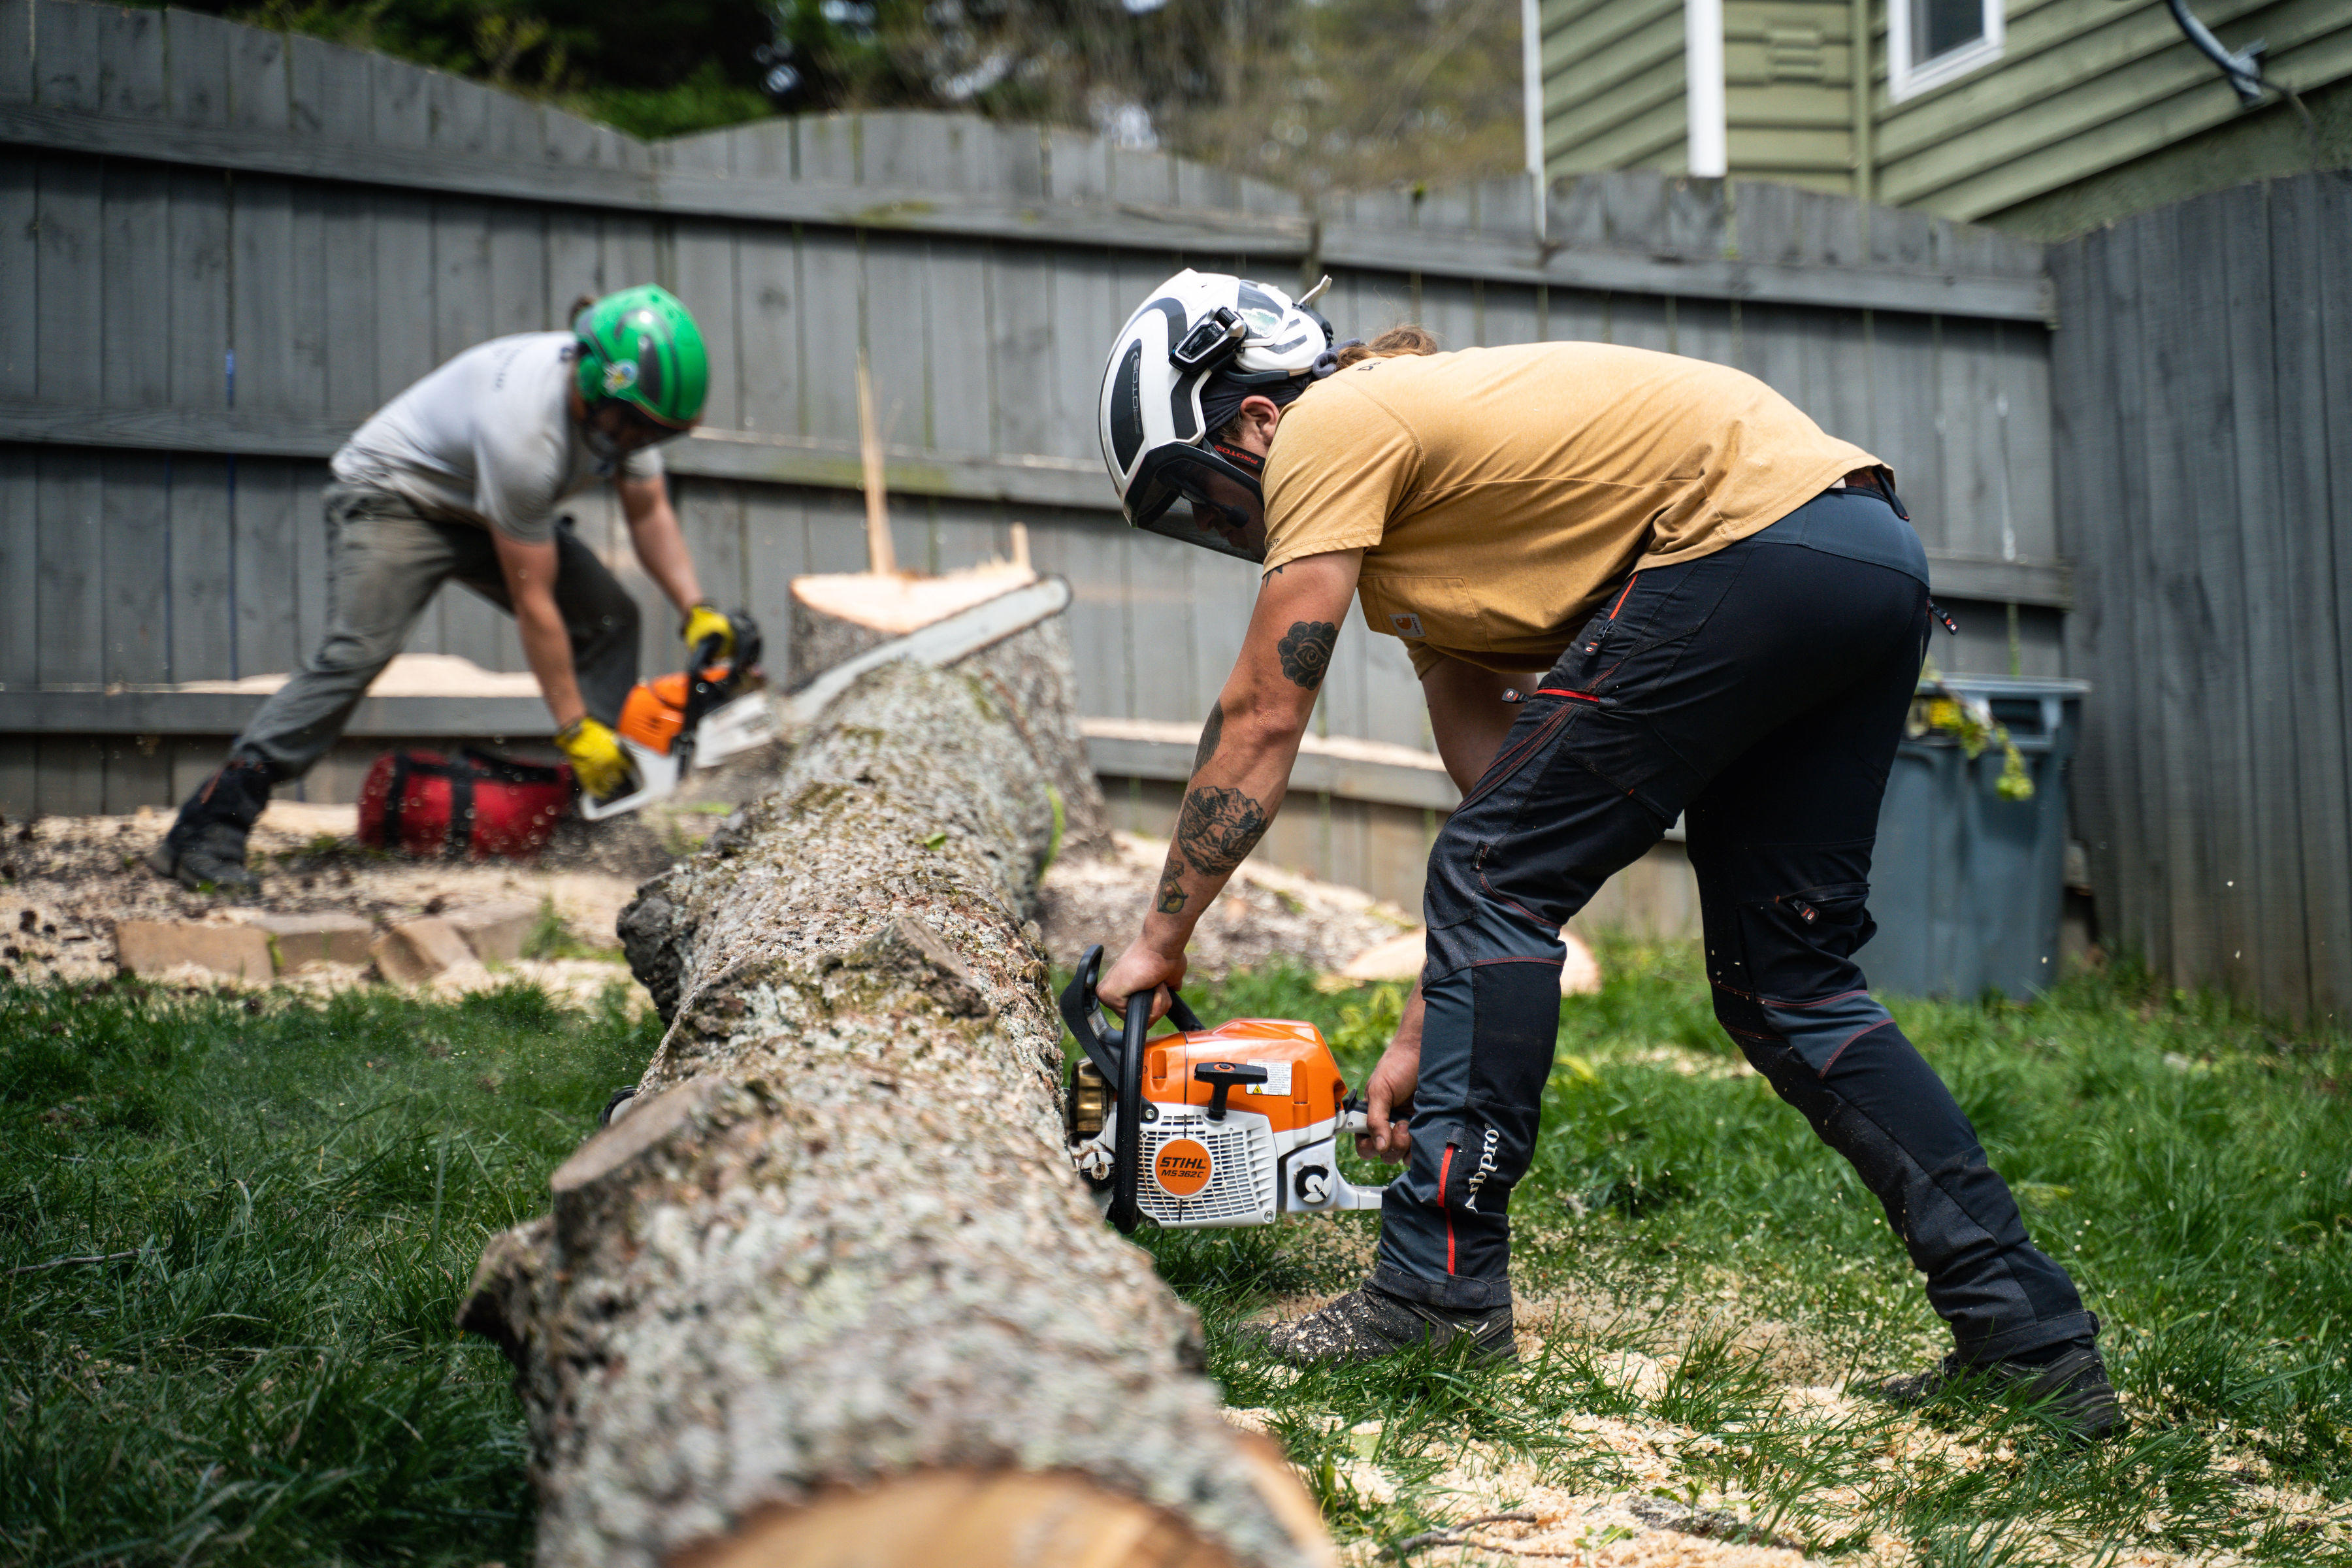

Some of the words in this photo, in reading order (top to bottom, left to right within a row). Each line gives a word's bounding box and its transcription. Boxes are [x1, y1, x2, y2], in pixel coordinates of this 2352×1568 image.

[1132, 358, 1141, 434] PROTOS
[1213, 444, 1258, 465] PROTOS
[1160, 1157, 1206, 1169] STIHL
[1465, 1130, 1499, 1213] Arbpro
